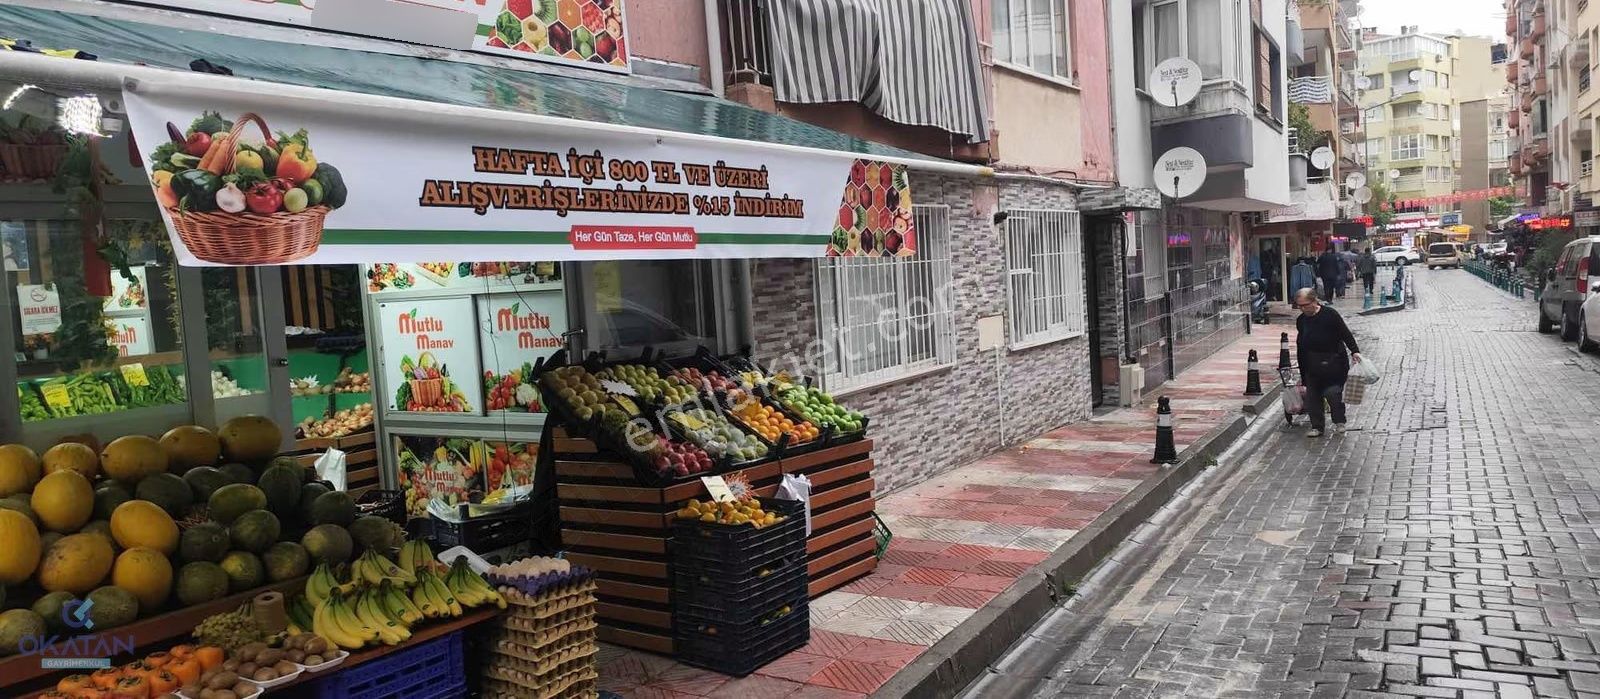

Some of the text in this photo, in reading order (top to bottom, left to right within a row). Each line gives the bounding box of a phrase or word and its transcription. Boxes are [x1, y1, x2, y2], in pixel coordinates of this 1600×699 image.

[472, 145, 769, 190] HAFTA İÇİ 800 TL VE ÜZERİ
[419, 178, 804, 218] ALIŞVERİŞLERİNİZDE %15 İNDİRİM
[575, 230, 693, 243] Her Gün Taze, Her Gün Mutlu
[398, 312, 443, 333] Mutlu
[497, 308, 551, 331] Mutlu
[416, 334, 454, 349] Manav
[518, 332, 563, 349] Manav
[424, 463, 455, 481] Mutlu
